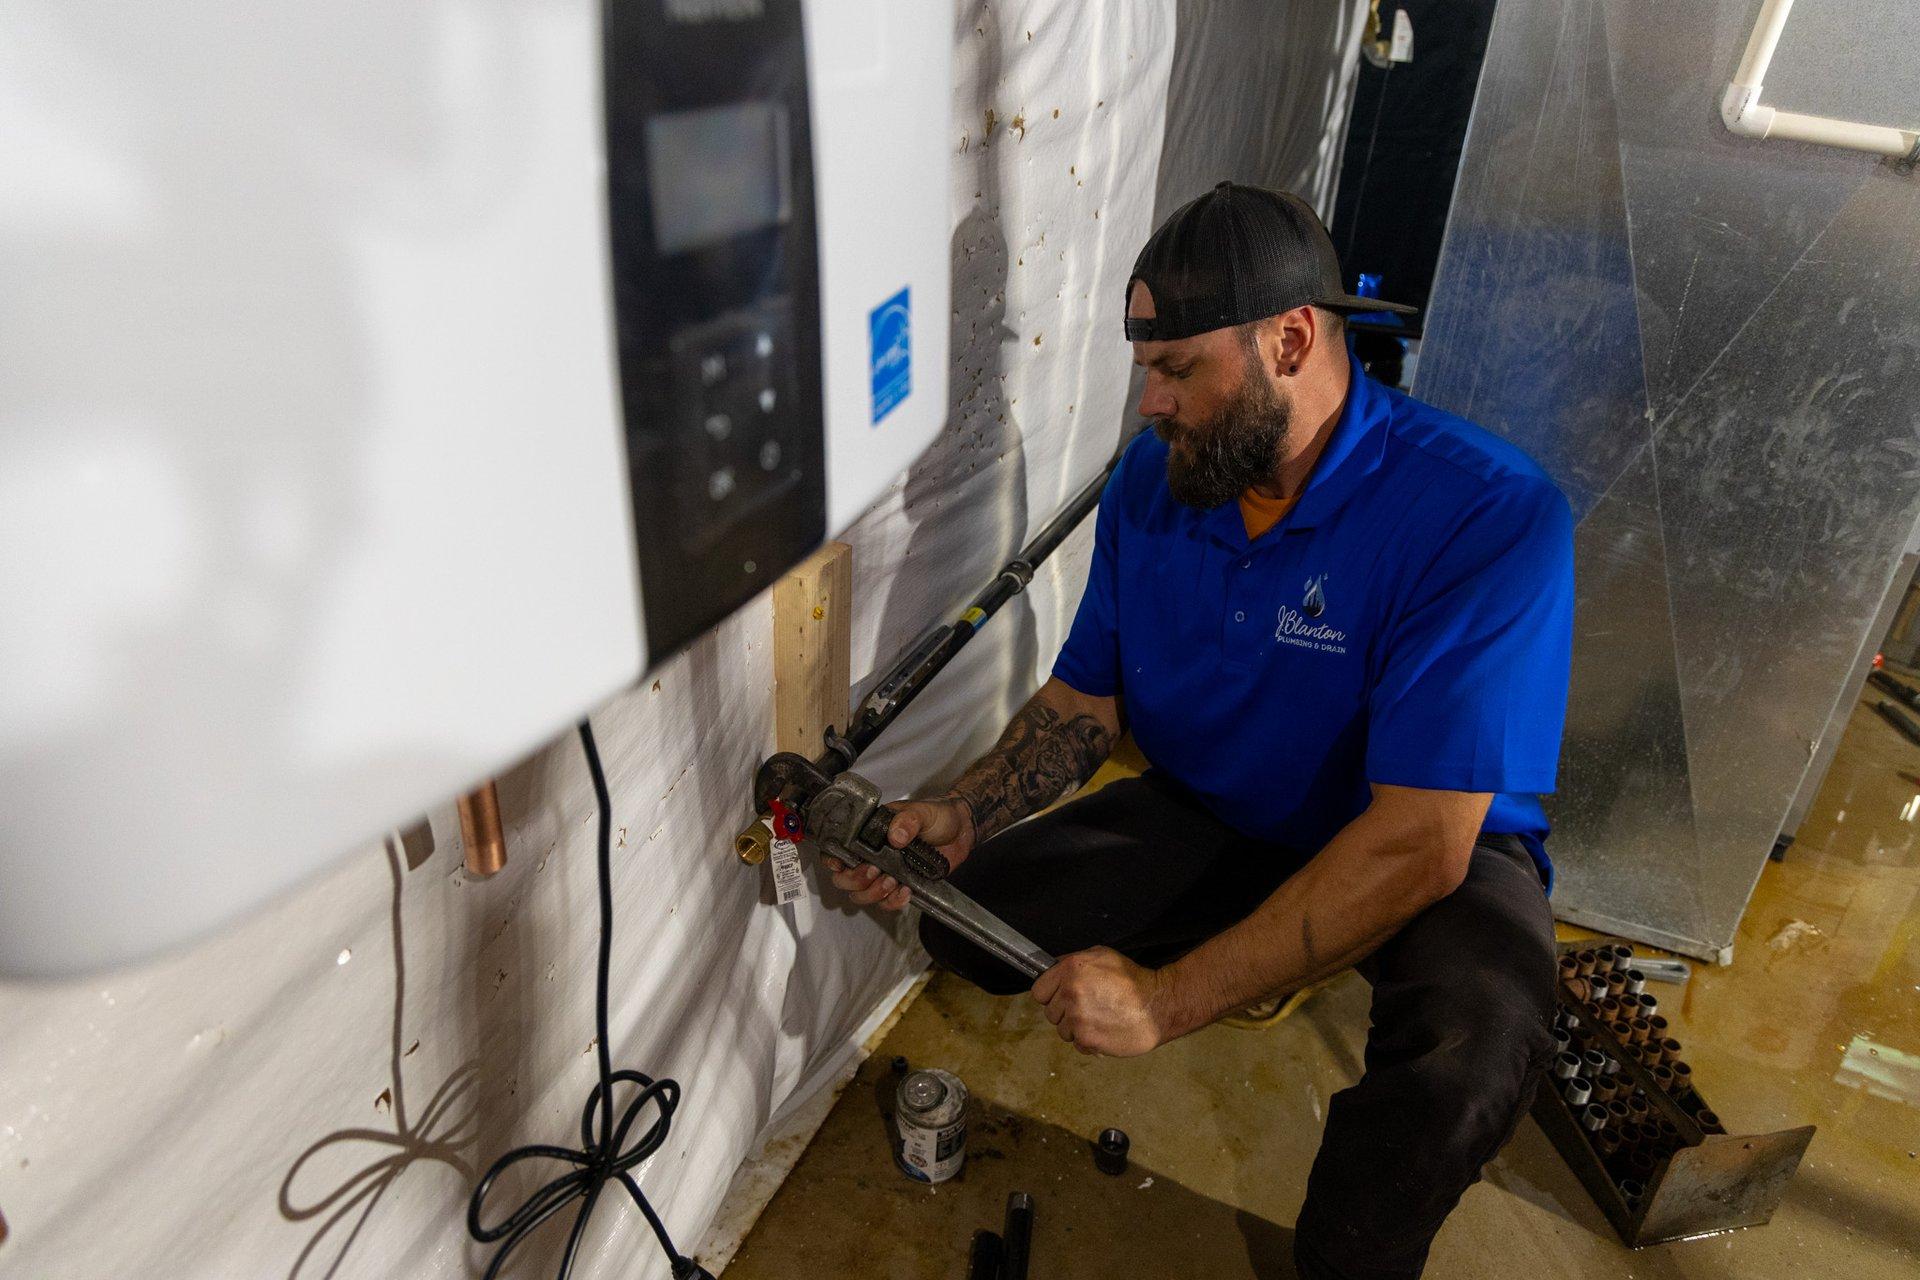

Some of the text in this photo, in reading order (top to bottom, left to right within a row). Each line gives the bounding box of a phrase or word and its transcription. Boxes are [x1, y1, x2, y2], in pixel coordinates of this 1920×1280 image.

[1276, 635, 1346, 654] PLUMBING & DRAIN
